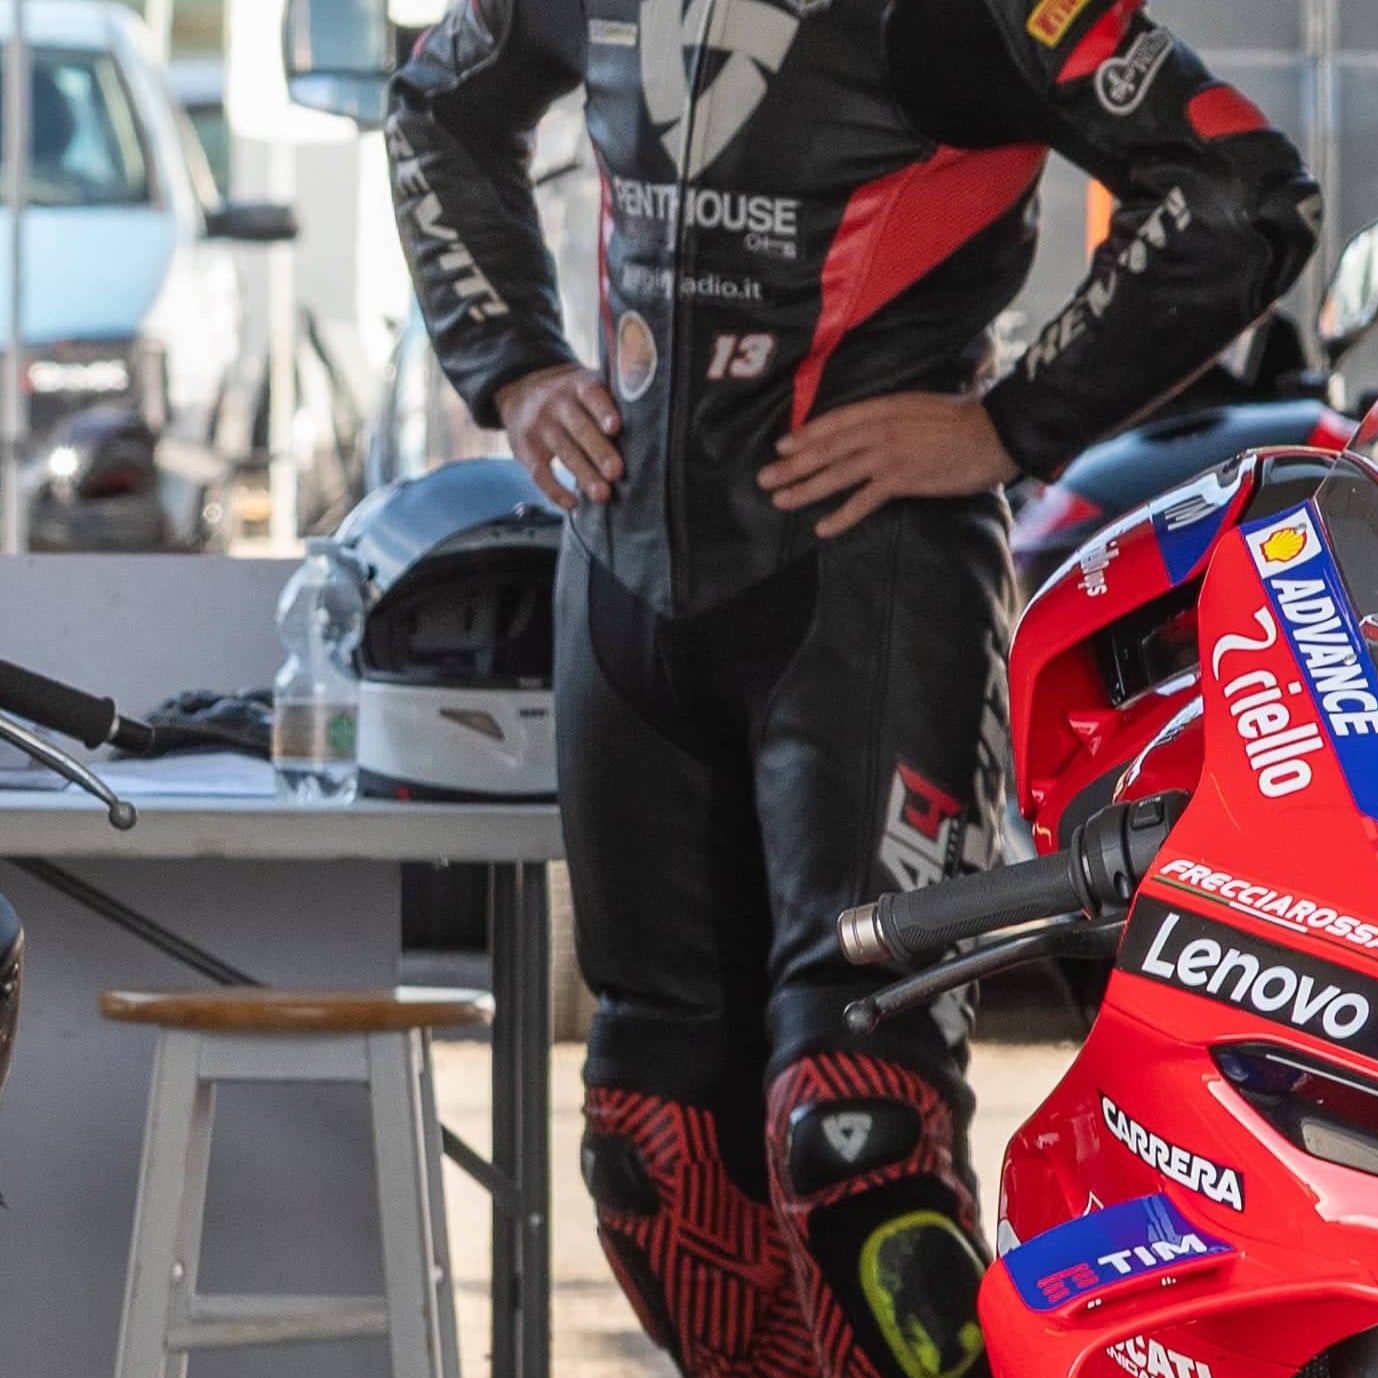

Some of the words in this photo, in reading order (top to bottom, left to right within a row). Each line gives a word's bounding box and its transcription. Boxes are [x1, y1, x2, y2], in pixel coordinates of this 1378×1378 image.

[706, 331, 775, 381] 13
[1223, 670, 1325, 799] riello
[1140, 911, 1371, 1040] Lenovo
[1101, 1094, 1244, 1213] CARRERA
[1097, 1232, 1208, 1276] TIM
